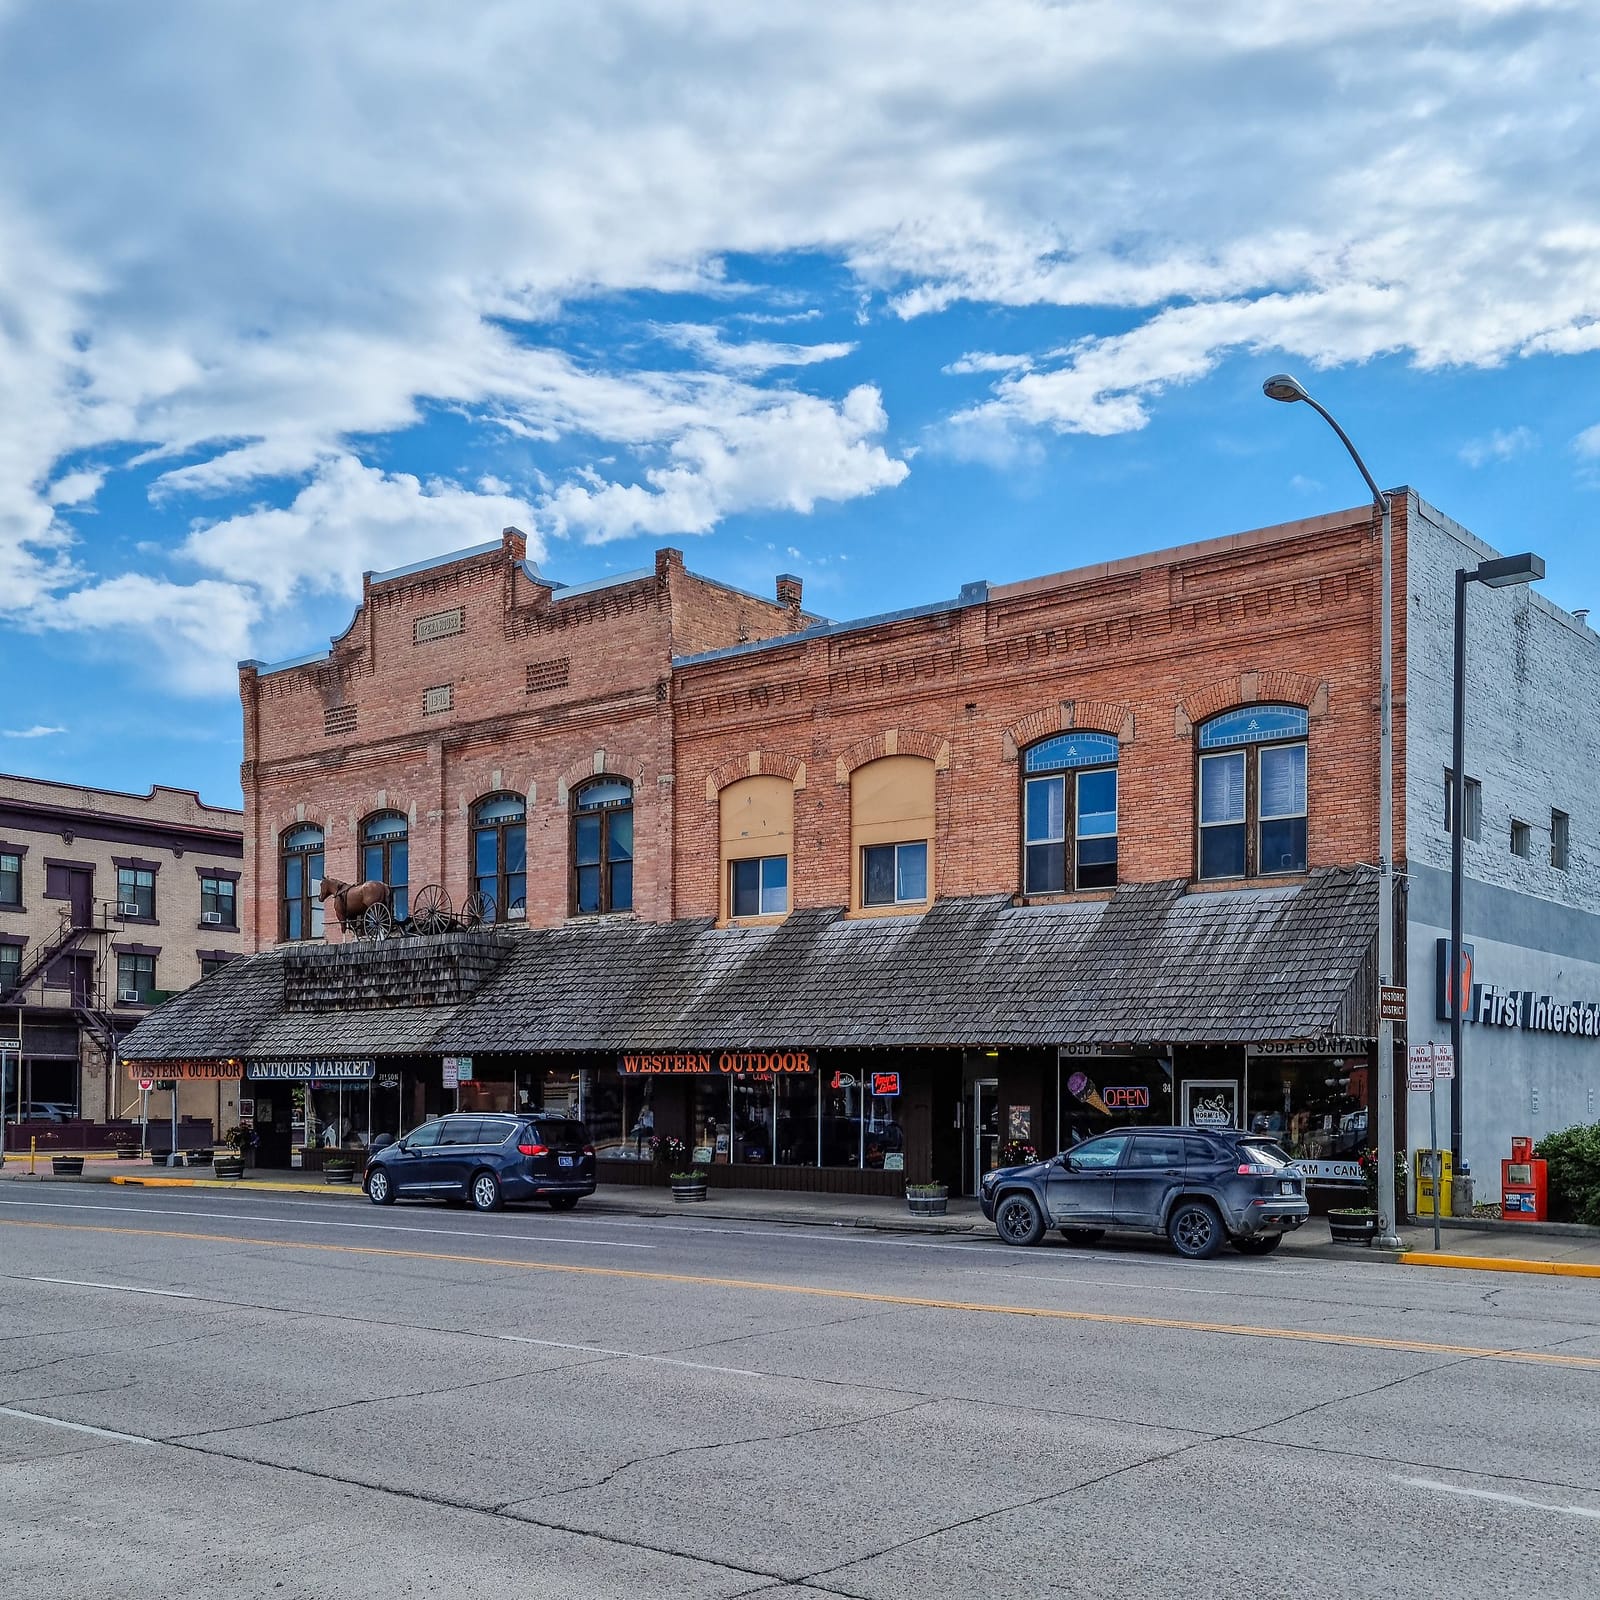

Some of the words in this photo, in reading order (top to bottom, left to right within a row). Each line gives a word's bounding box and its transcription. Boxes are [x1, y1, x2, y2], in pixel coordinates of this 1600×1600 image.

[1382, 991, 1405, 1002] HISTORIC
[1382, 1005, 1405, 1015] DISTRICT
[1478, 983, 1522, 1027] First
[1529, 992, 1600, 1036] Interstat
[1257, 1042, 1294, 1053] SODA
[1298, 1040, 1368, 1053] FOUNTAIN
[131, 1064, 184, 1078] WESTERN
[188, 1063, 240, 1078] OUTDOOR
[252, 1062, 312, 1078] ANTIQUES
[315, 1061, 370, 1077] MARKET
[623, 1055, 711, 1073] WESTERN
[719, 1053, 810, 1073] OUTDOOR
[1105, 1089, 1148, 1106] OPEN
[1301, 1164, 1318, 1175] AM
